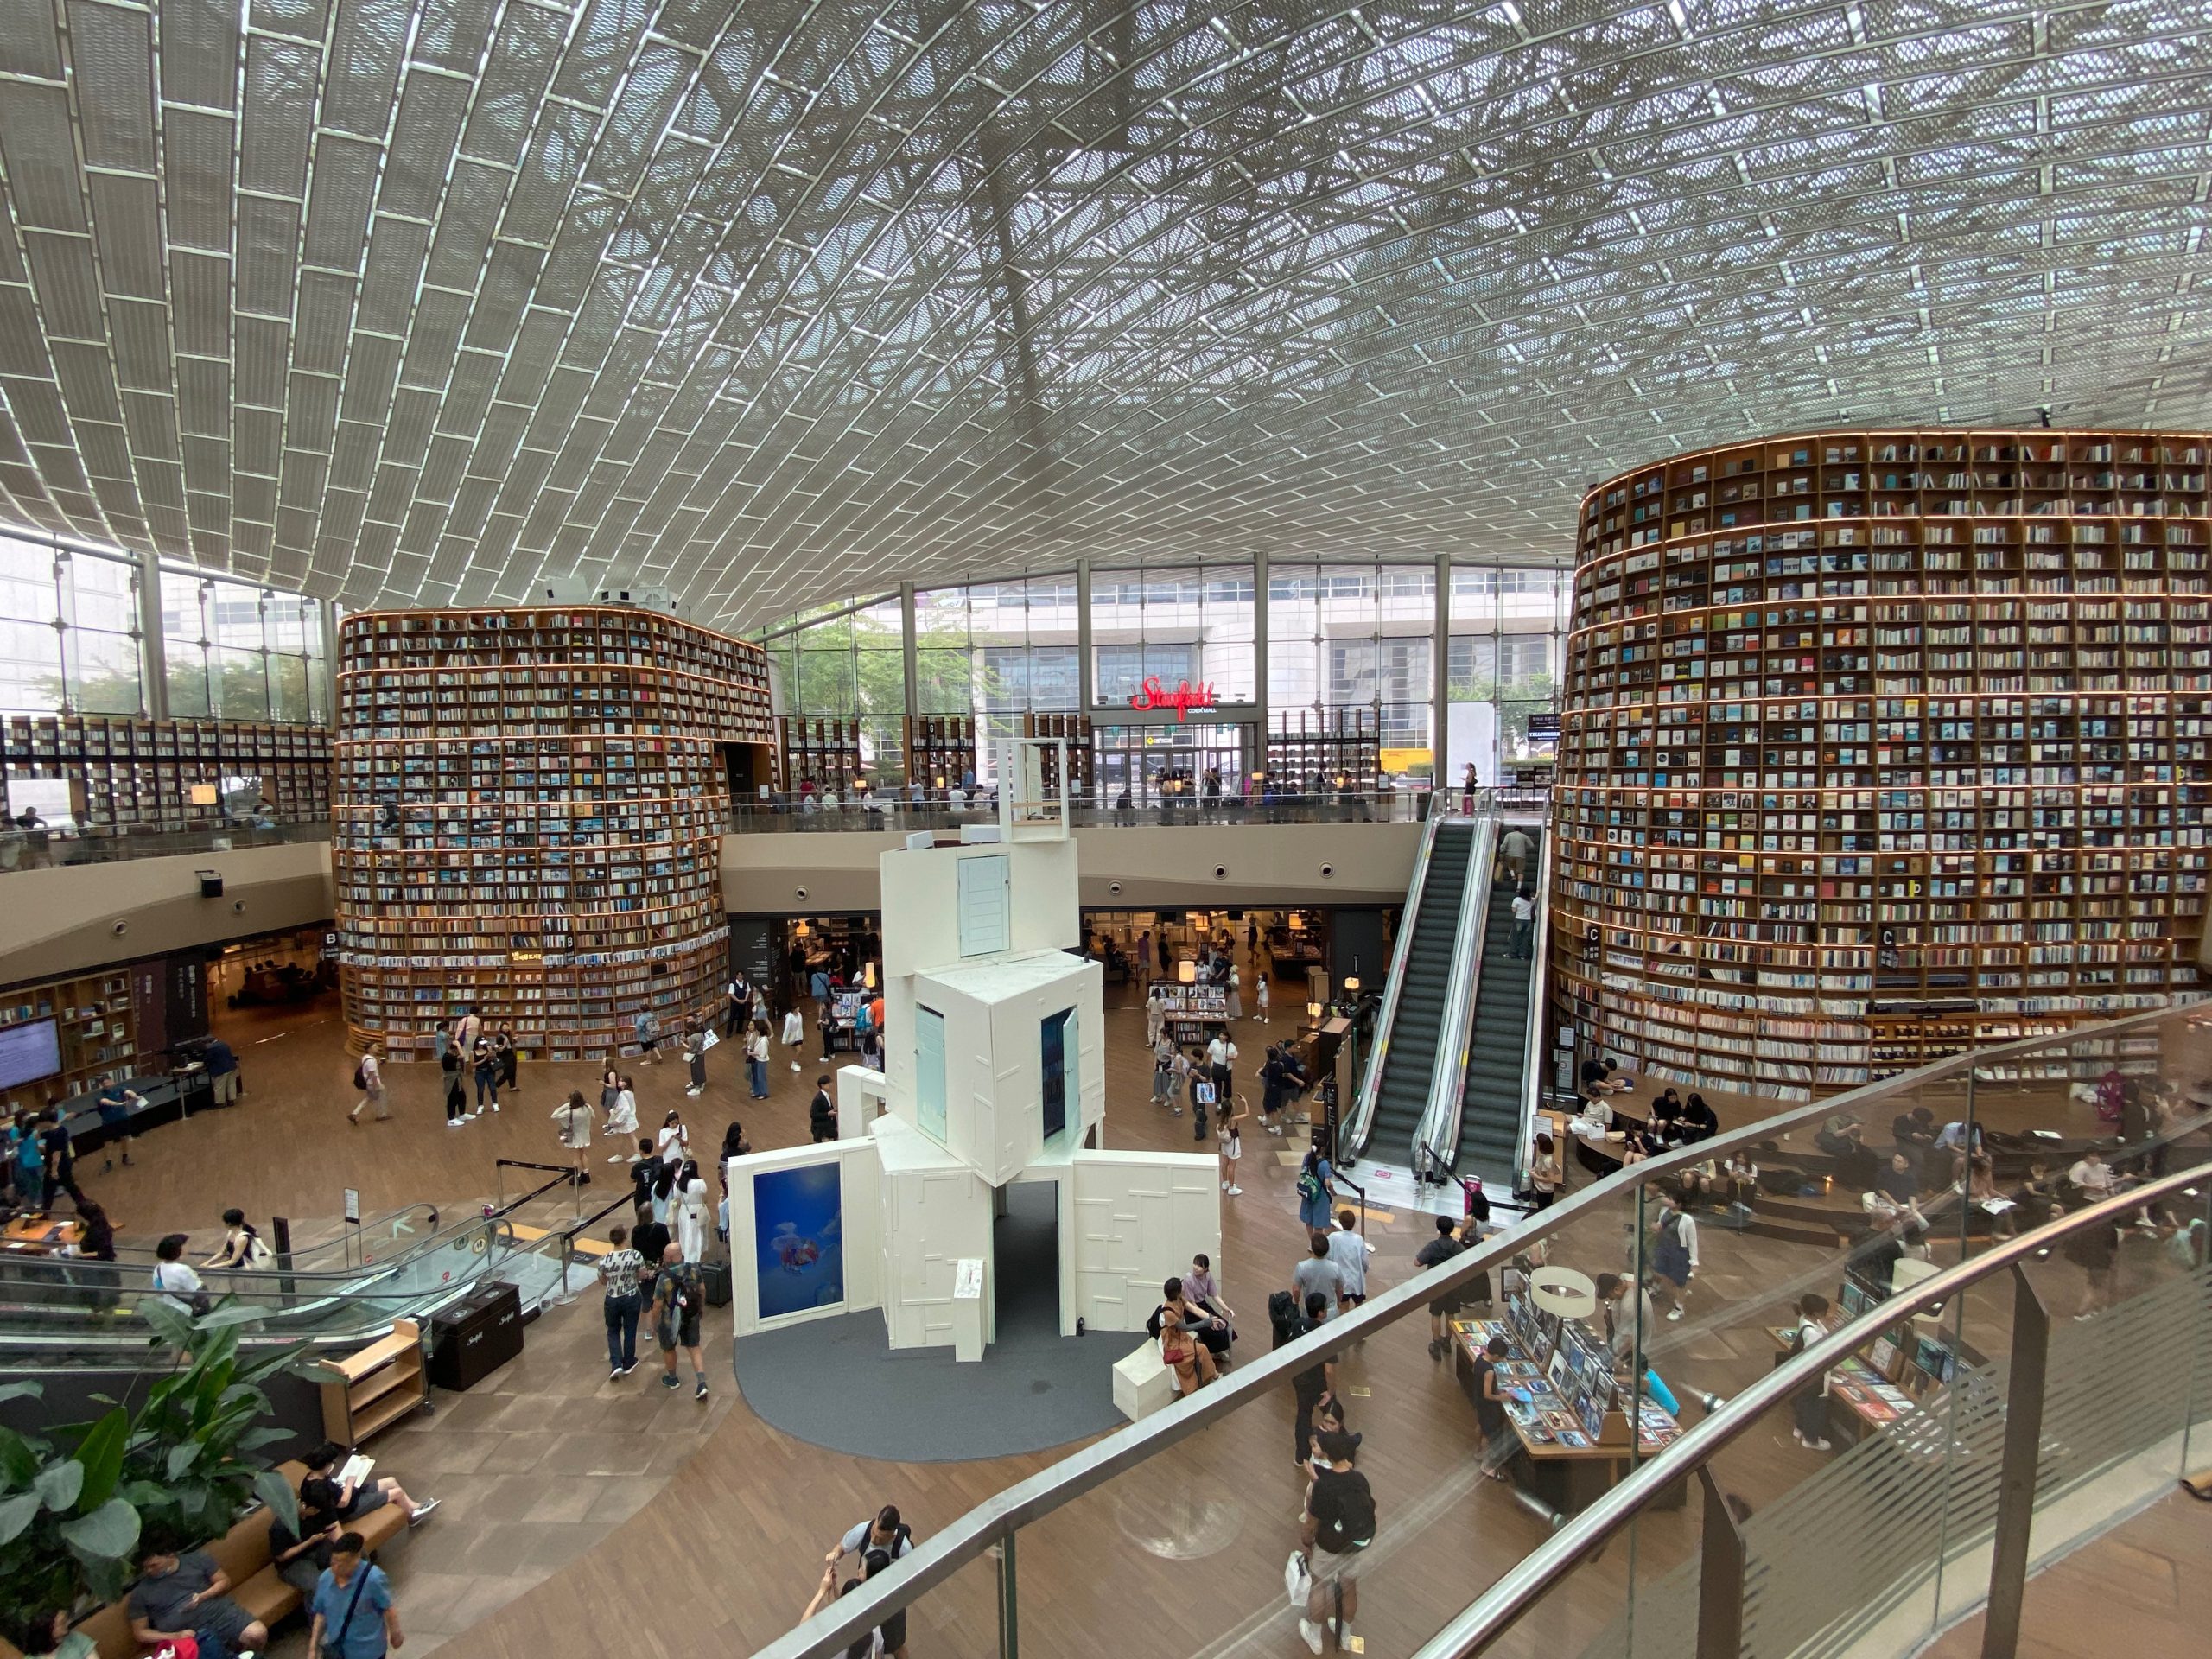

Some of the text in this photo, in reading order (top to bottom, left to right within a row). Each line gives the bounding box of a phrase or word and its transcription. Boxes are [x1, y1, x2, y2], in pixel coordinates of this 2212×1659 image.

[326, 933, 336, 944] B
[1590, 928, 1599, 941] C
[1883, 931, 1893, 945] C
